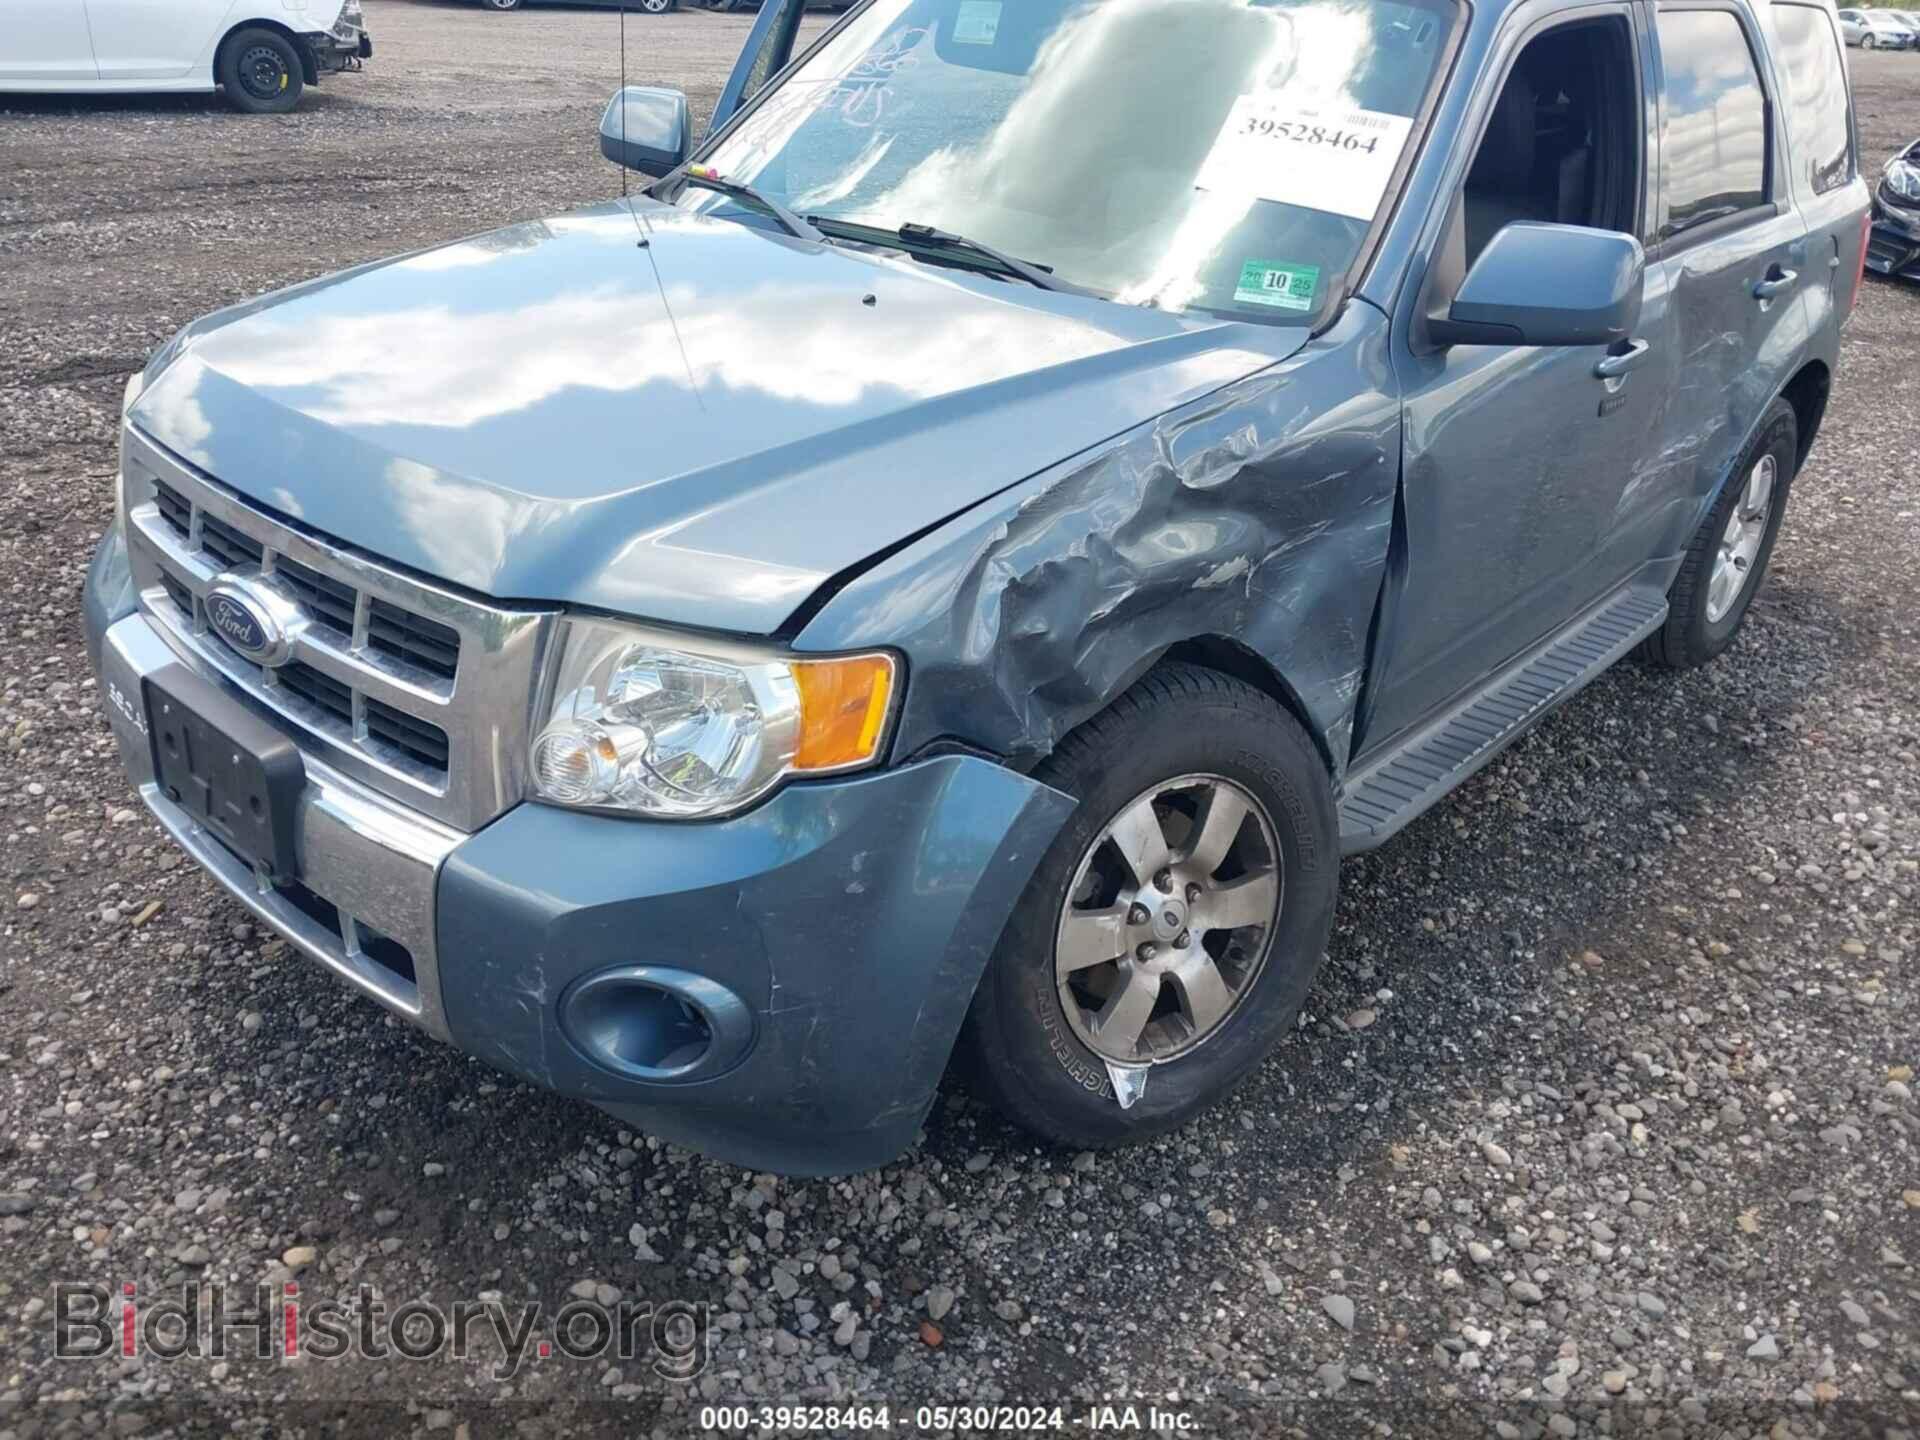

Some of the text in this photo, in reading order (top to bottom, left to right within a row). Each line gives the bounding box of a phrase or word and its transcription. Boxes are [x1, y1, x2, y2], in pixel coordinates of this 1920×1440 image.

[1238, 117, 1379, 154] 39528464
[1266, 271, 1288, 289] 10
[215, 600, 253, 643] Ford
